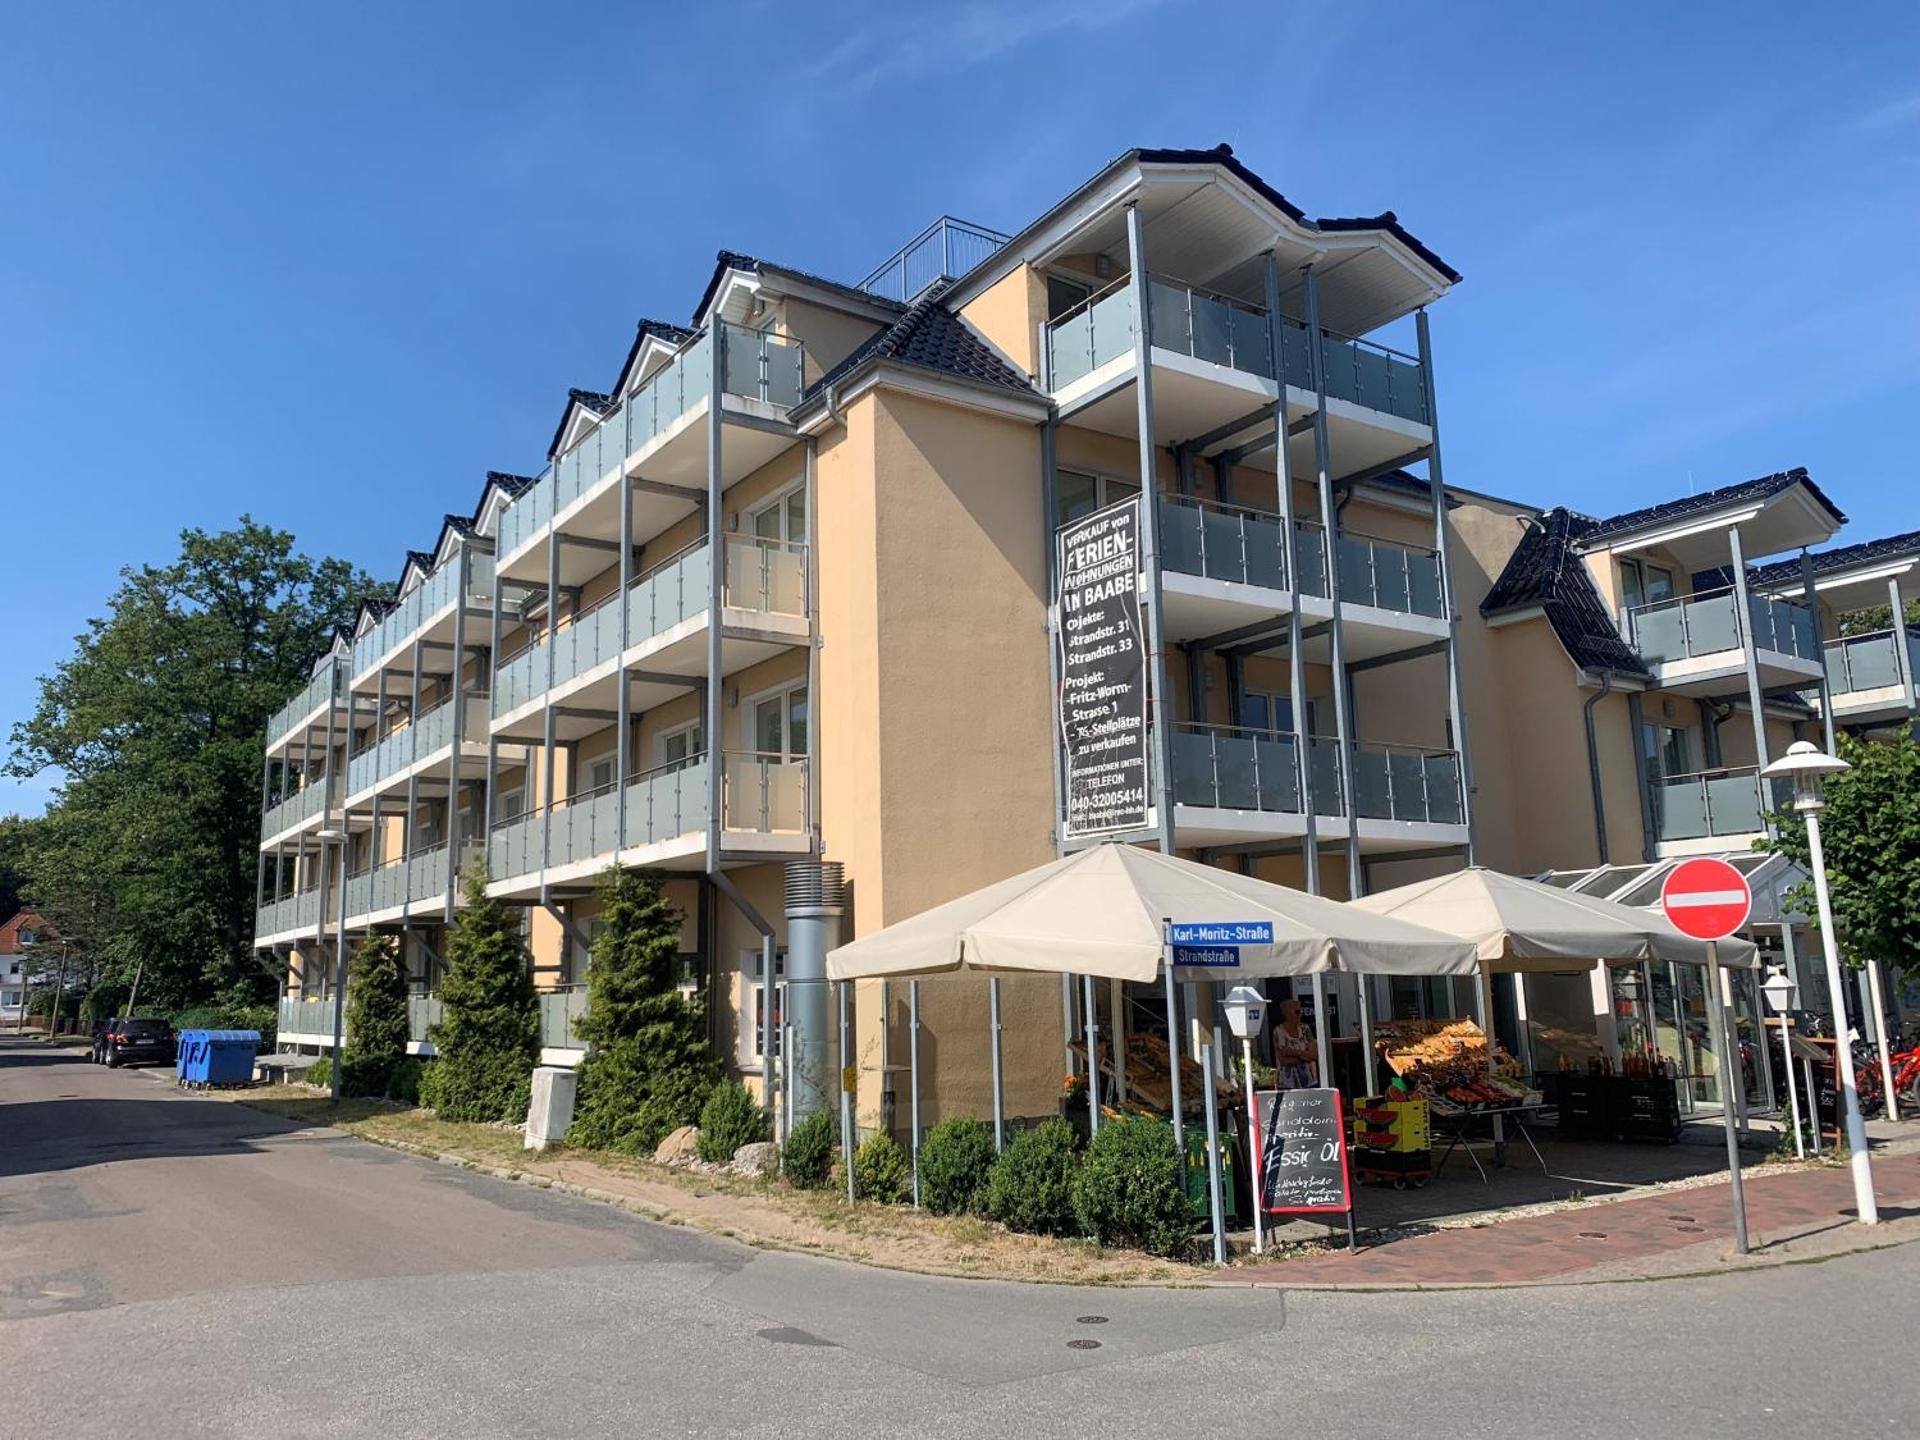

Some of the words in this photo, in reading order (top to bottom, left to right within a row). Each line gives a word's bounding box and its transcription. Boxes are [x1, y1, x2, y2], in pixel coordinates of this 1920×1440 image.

[1066, 519, 1110, 549] VERKAUF
[1111, 514, 1130, 529] von
[1067, 530, 1134, 571] FERIEN-
[1064, 554, 1134, 590] WOHNUNGEN
[1065, 590, 1080, 612] IN
[1085, 573, 1135, 606] BAABE
[1067, 611, 1105, 631] Objekte:
[1068, 625, 1116, 647] Strandstr.
[1118, 619, 1130, 633] 31
[1067, 644, 1117, 666] Strandstr.
[1119, 638, 1133, 653] 33
[1065, 672, 1105, 690] Projekt:
[1072, 705, 1111, 722] Strasse
[1112, 701, 1118, 713] 1
[1079, 744, 1089, 755] zu
[1090, 734, 1137, 752] verkaufen
[1088, 773, 1125, 789] TELEFON
[1071, 787, 1143, 811] 040-32005414
[1173, 926, 1270, 941] Karl-Moritz-Straße
[1179, 949, 1235, 963] Strandstraße
